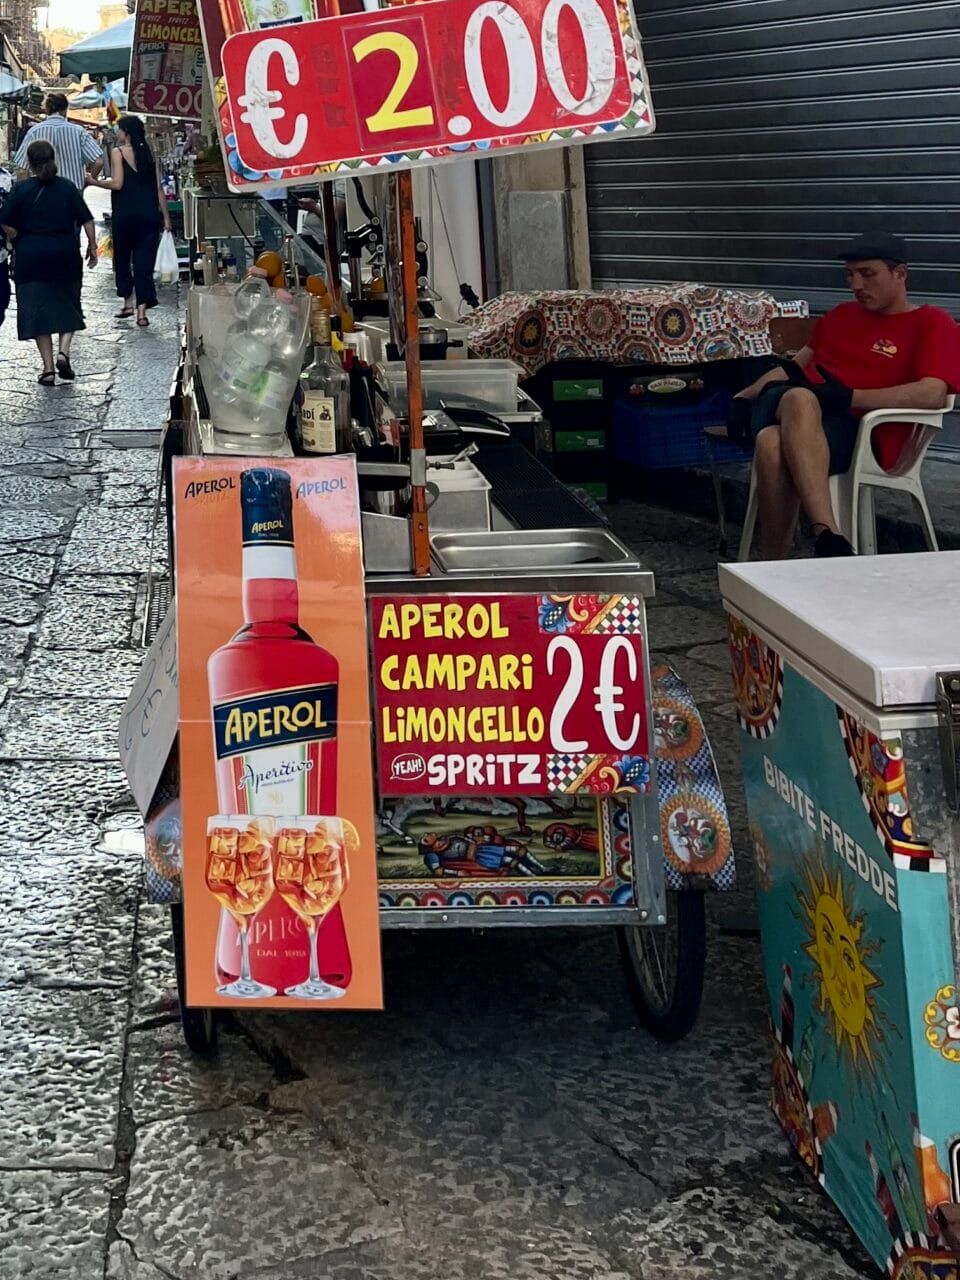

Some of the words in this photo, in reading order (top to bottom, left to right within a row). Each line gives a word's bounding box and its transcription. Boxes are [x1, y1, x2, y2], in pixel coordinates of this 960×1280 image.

[132, 83, 148, 112] €
[238, 38, 309, 159] €
[185, 477, 236, 499] APEROL
[296, 478, 347, 499] APEROL
[251, 519, 284, 534] APEROL
[378, 602, 509, 640] APEROL
[224, 699, 328, 746] APEROL
[238, 760, 314, 794] Aperitivo
[393, 758, 423, 776] YEAH!
[763, 754, 817, 832] BIBITE
[819, 809, 898, 913] FREDDE
